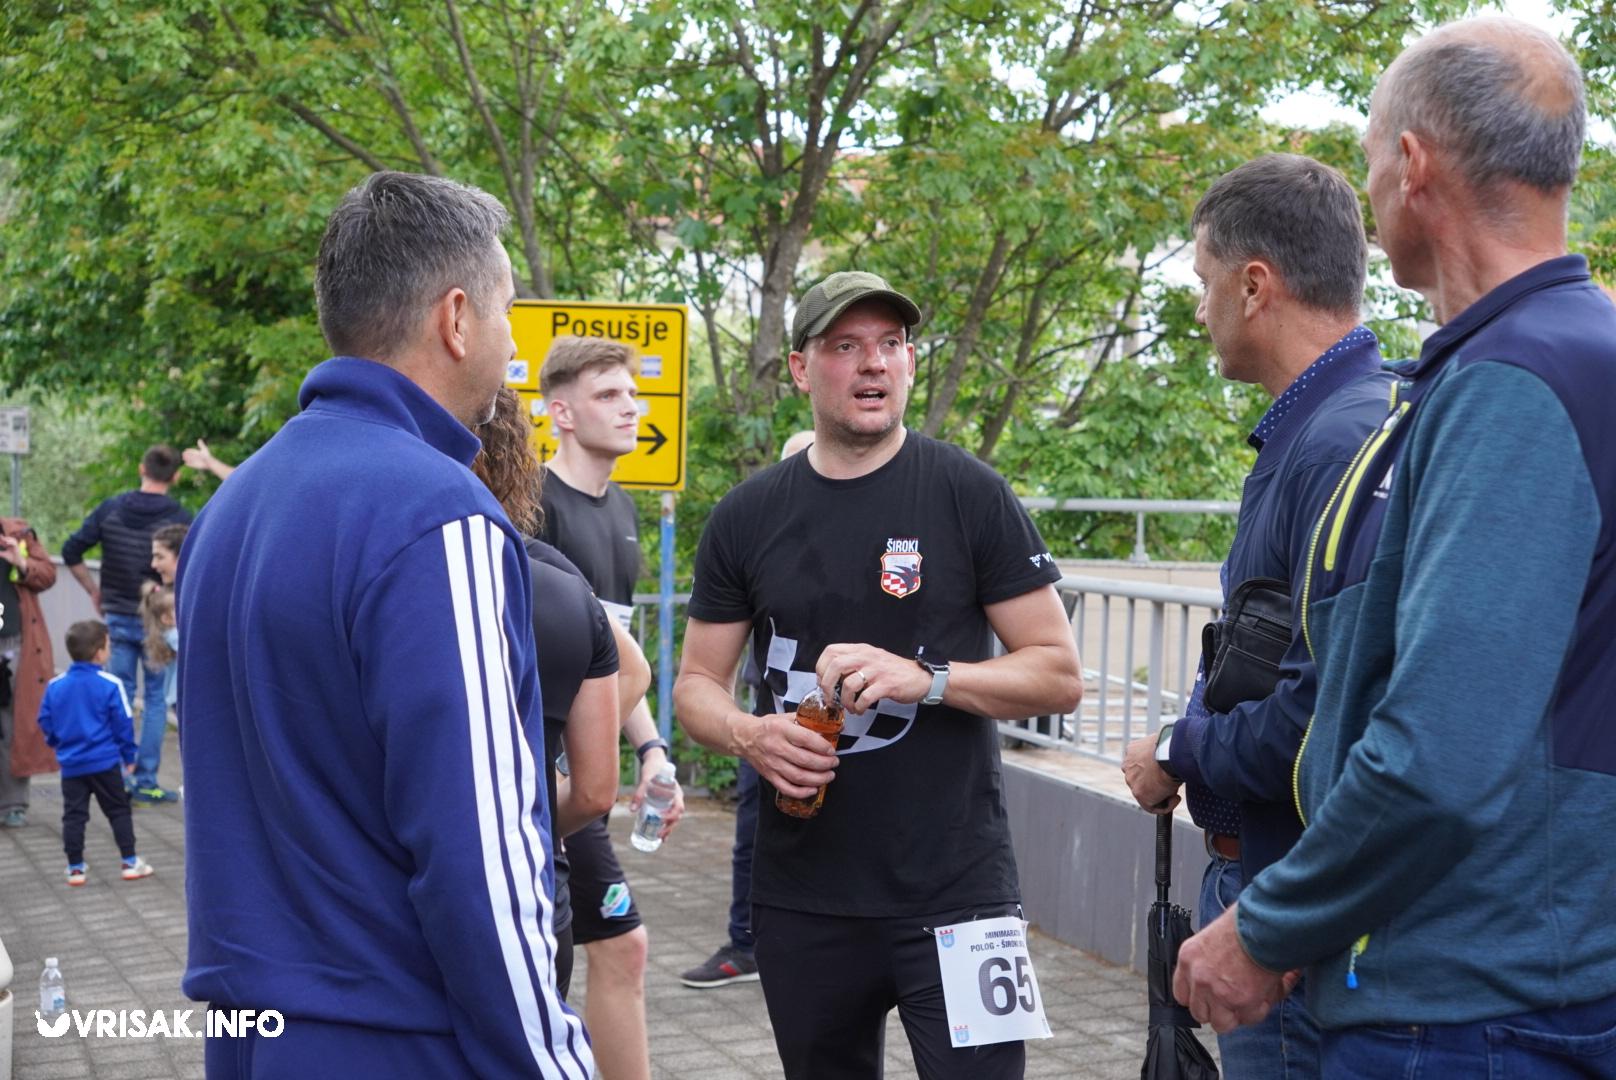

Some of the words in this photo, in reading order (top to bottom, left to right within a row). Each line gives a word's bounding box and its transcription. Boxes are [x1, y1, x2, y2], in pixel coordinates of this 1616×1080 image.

[552, 312, 668, 347] Posušje
[886, 537, 919, 552] ŠIROKI
[970, 942, 995, 952] POLOG
[978, 956, 1036, 1016] 65
